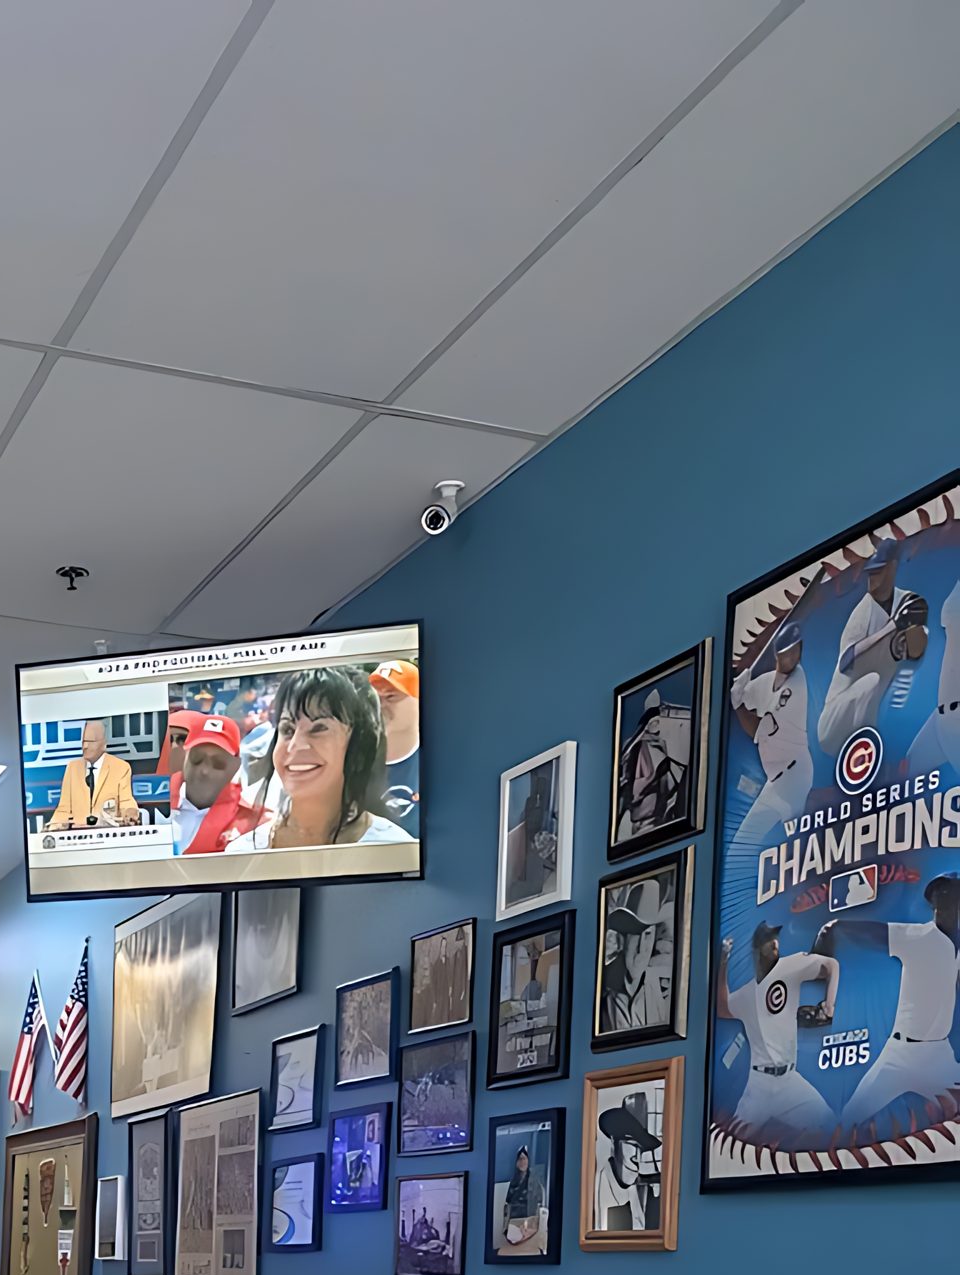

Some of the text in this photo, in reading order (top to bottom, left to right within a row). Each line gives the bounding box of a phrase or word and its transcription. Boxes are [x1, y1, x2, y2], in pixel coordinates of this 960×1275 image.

[784, 770, 940, 838] WORLD SERIES
[757, 785, 960, 906] CHAMPIONS
[818, 1042, 870, 1070] CUBS
